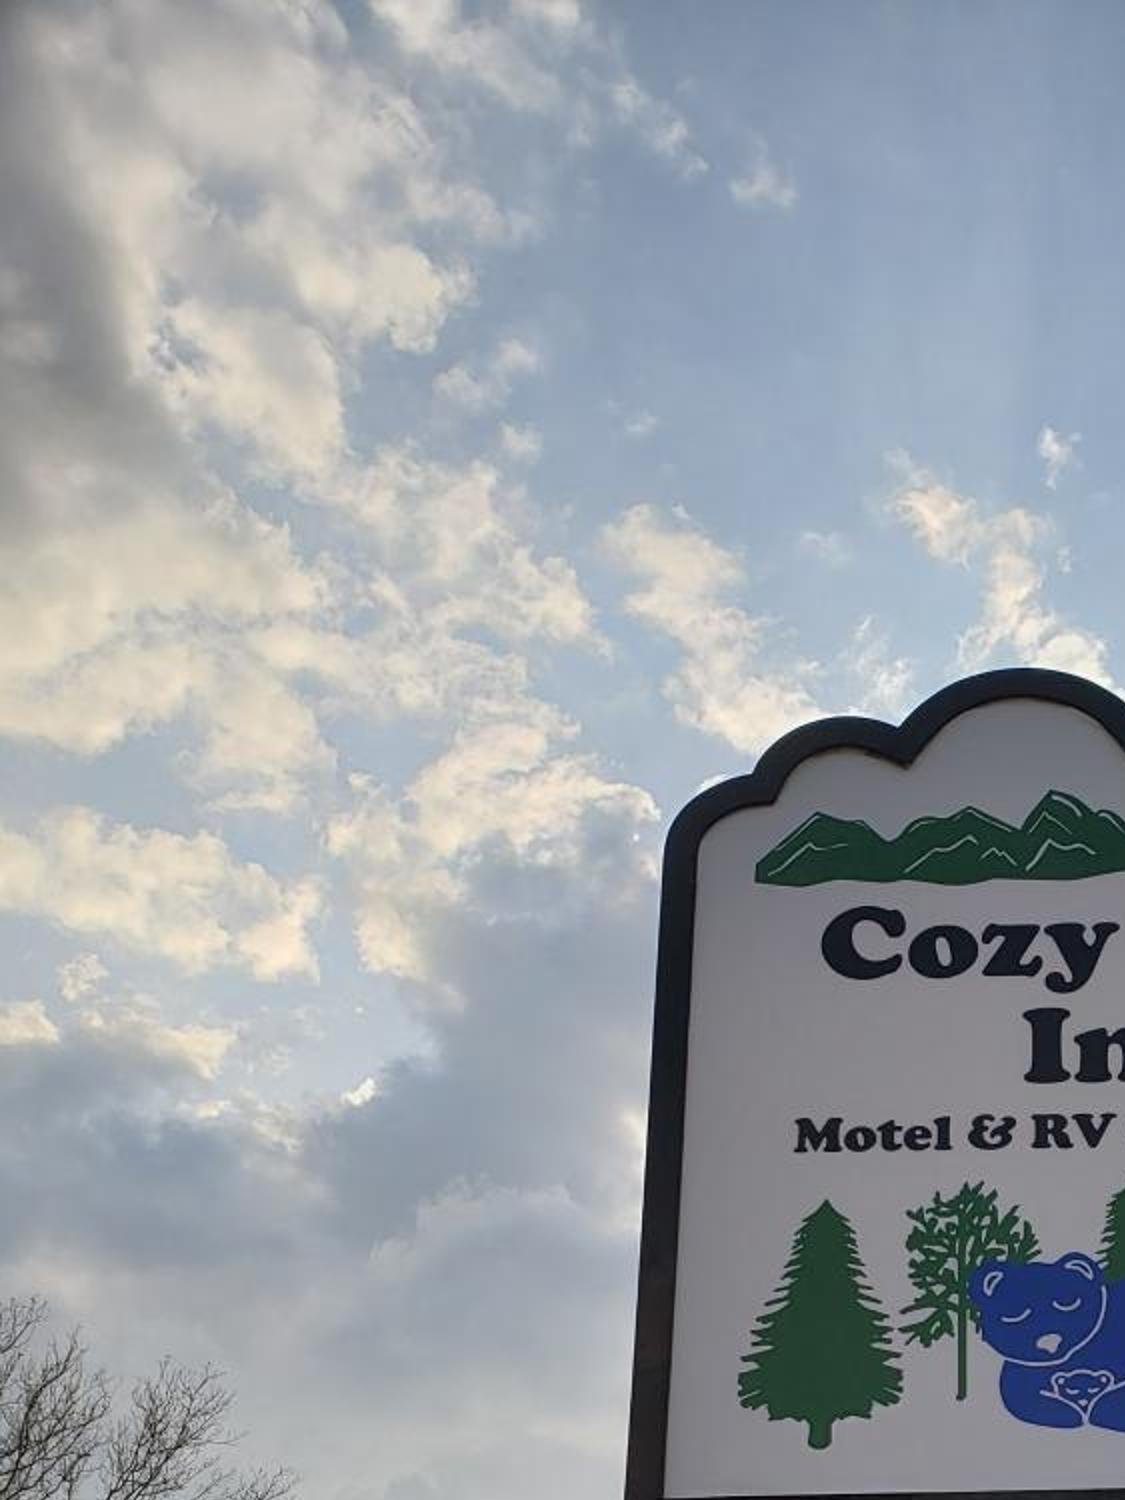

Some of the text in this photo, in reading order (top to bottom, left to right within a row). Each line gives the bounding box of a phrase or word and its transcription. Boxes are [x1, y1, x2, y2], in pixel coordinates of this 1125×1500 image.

[821, 906, 1120, 994] Cozy
[794, 1116, 952, 1153] Motel
[968, 1114, 1016, 1150] &
[1032, 1113, 1117, 1149] RV
